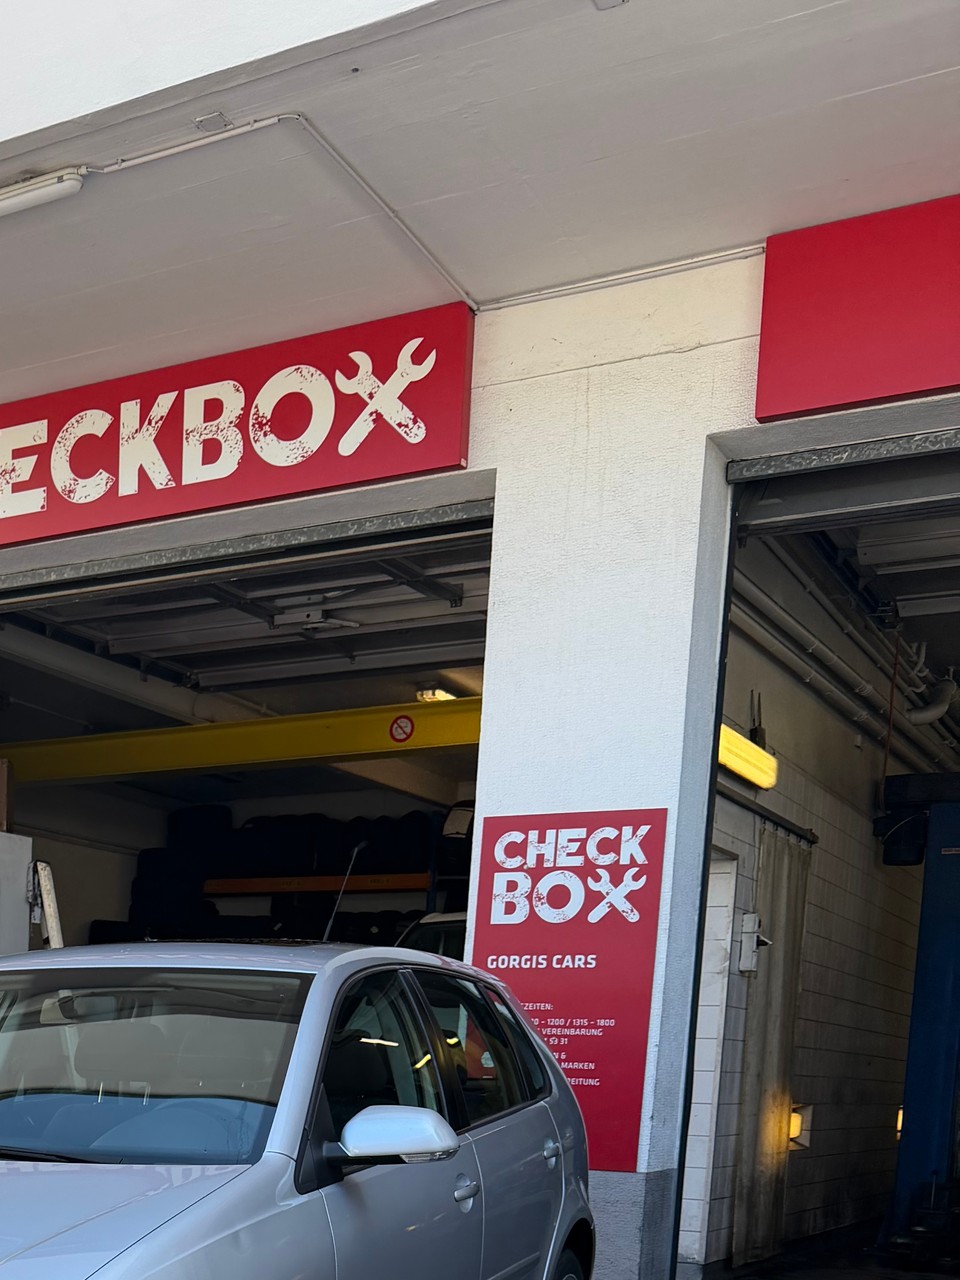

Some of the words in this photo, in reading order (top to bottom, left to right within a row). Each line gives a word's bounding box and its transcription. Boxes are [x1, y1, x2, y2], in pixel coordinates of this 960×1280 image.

[494, 825, 652, 869] CHECK
[487, 955, 547, 969] GORGIS
[552, 954, 597, 968] CARS
[541, 1027, 603, 1036] VEREINBARUNG
[560, 1037, 568, 1045] 31
[560, 1062, 595, 1070] MARKEN
